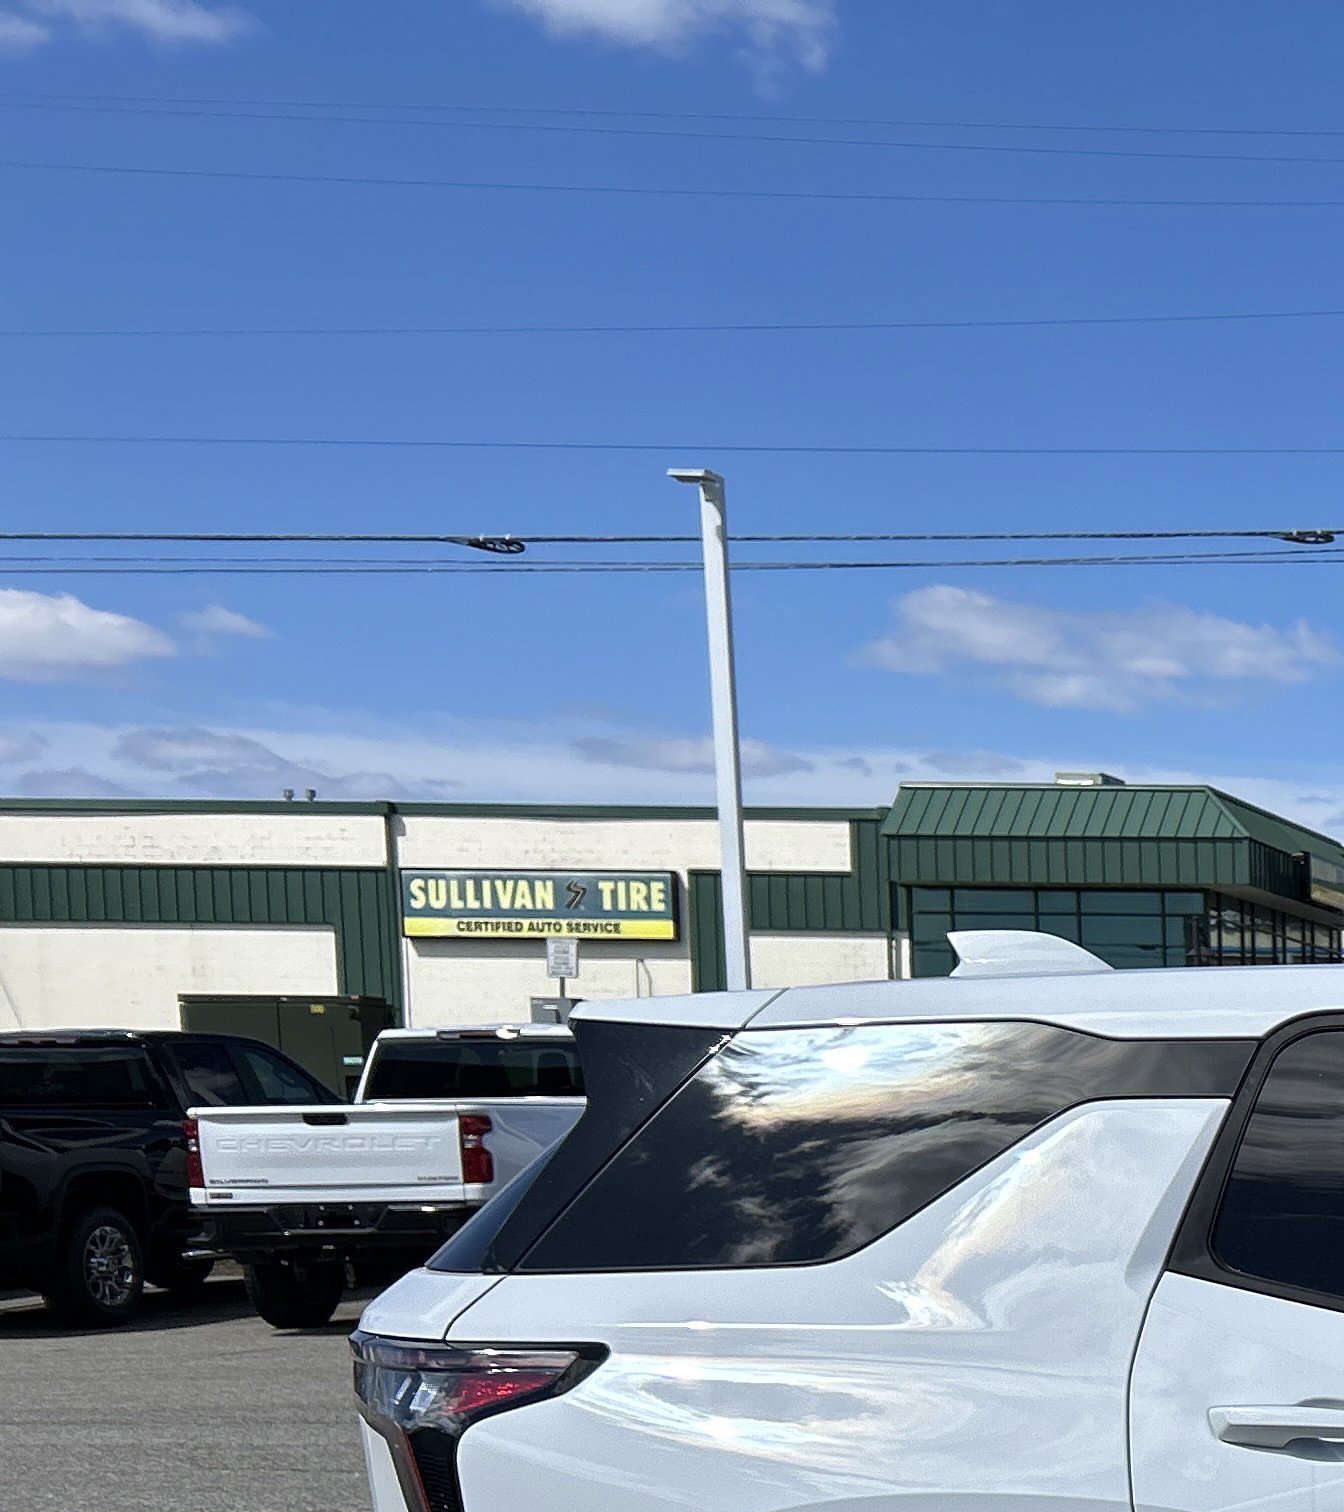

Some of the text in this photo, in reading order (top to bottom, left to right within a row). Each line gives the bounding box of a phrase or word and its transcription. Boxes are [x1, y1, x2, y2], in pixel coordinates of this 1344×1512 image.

[408, 877, 666, 912] SULLIVAN TIRE
[456, 920, 622, 935] CERTIFIED AUTO SERVICE
[215, 1134, 443, 1153] CHEVROLET
